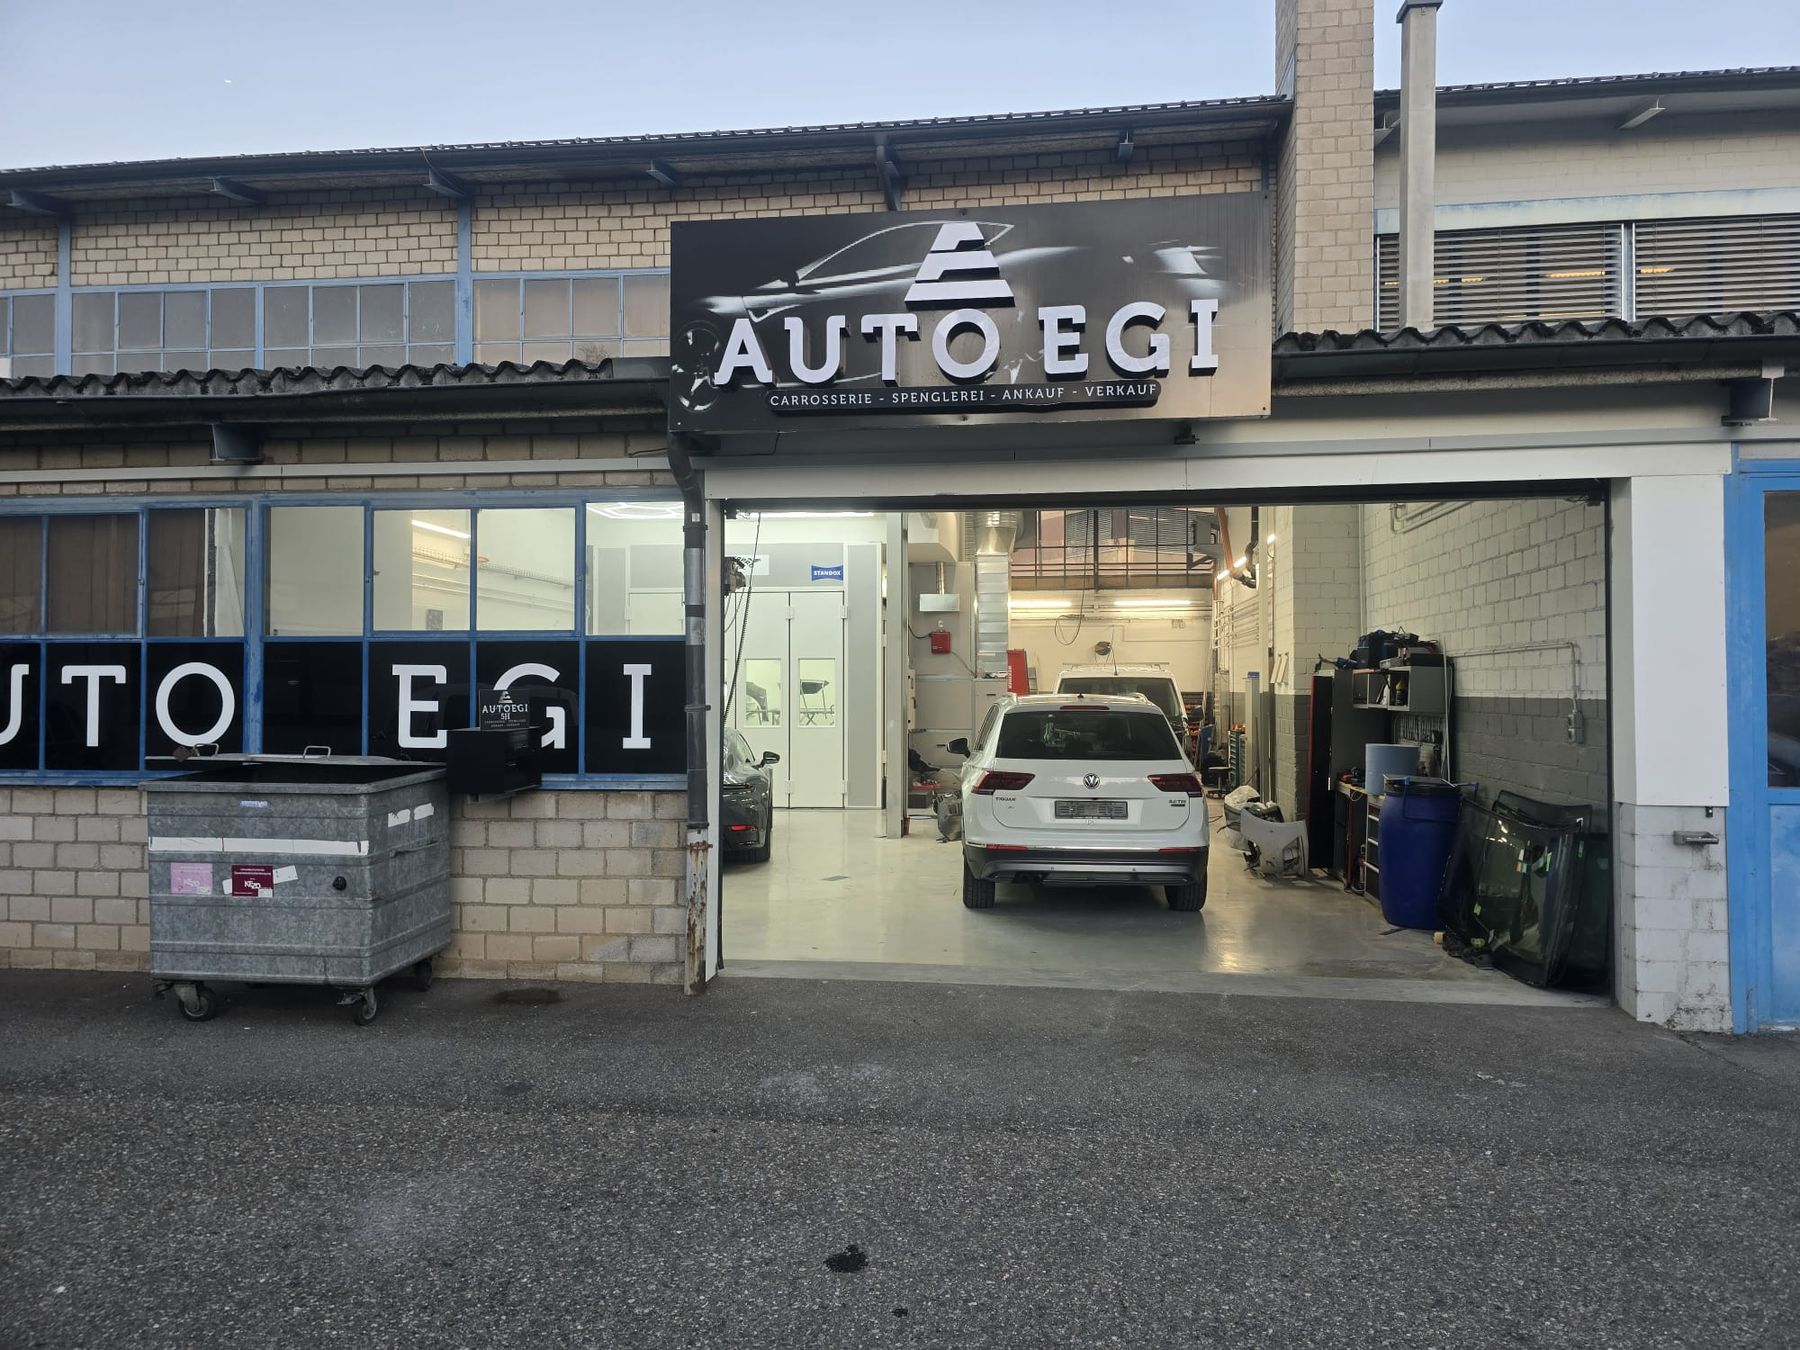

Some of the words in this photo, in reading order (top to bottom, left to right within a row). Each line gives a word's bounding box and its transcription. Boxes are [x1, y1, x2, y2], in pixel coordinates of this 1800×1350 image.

[714, 308, 1000, 385] AUTO
[1038, 298, 1219, 375] EGI
[770, 393, 872, 406] CARROSSERIE
[892, 390, 984, 403] SPENGLEREI
[1002, 387, 1065, 400] ANKAUF
[1085, 384, 1157, 397] VERKAUF
[482, 703, 528, 713] AUTOEGI
